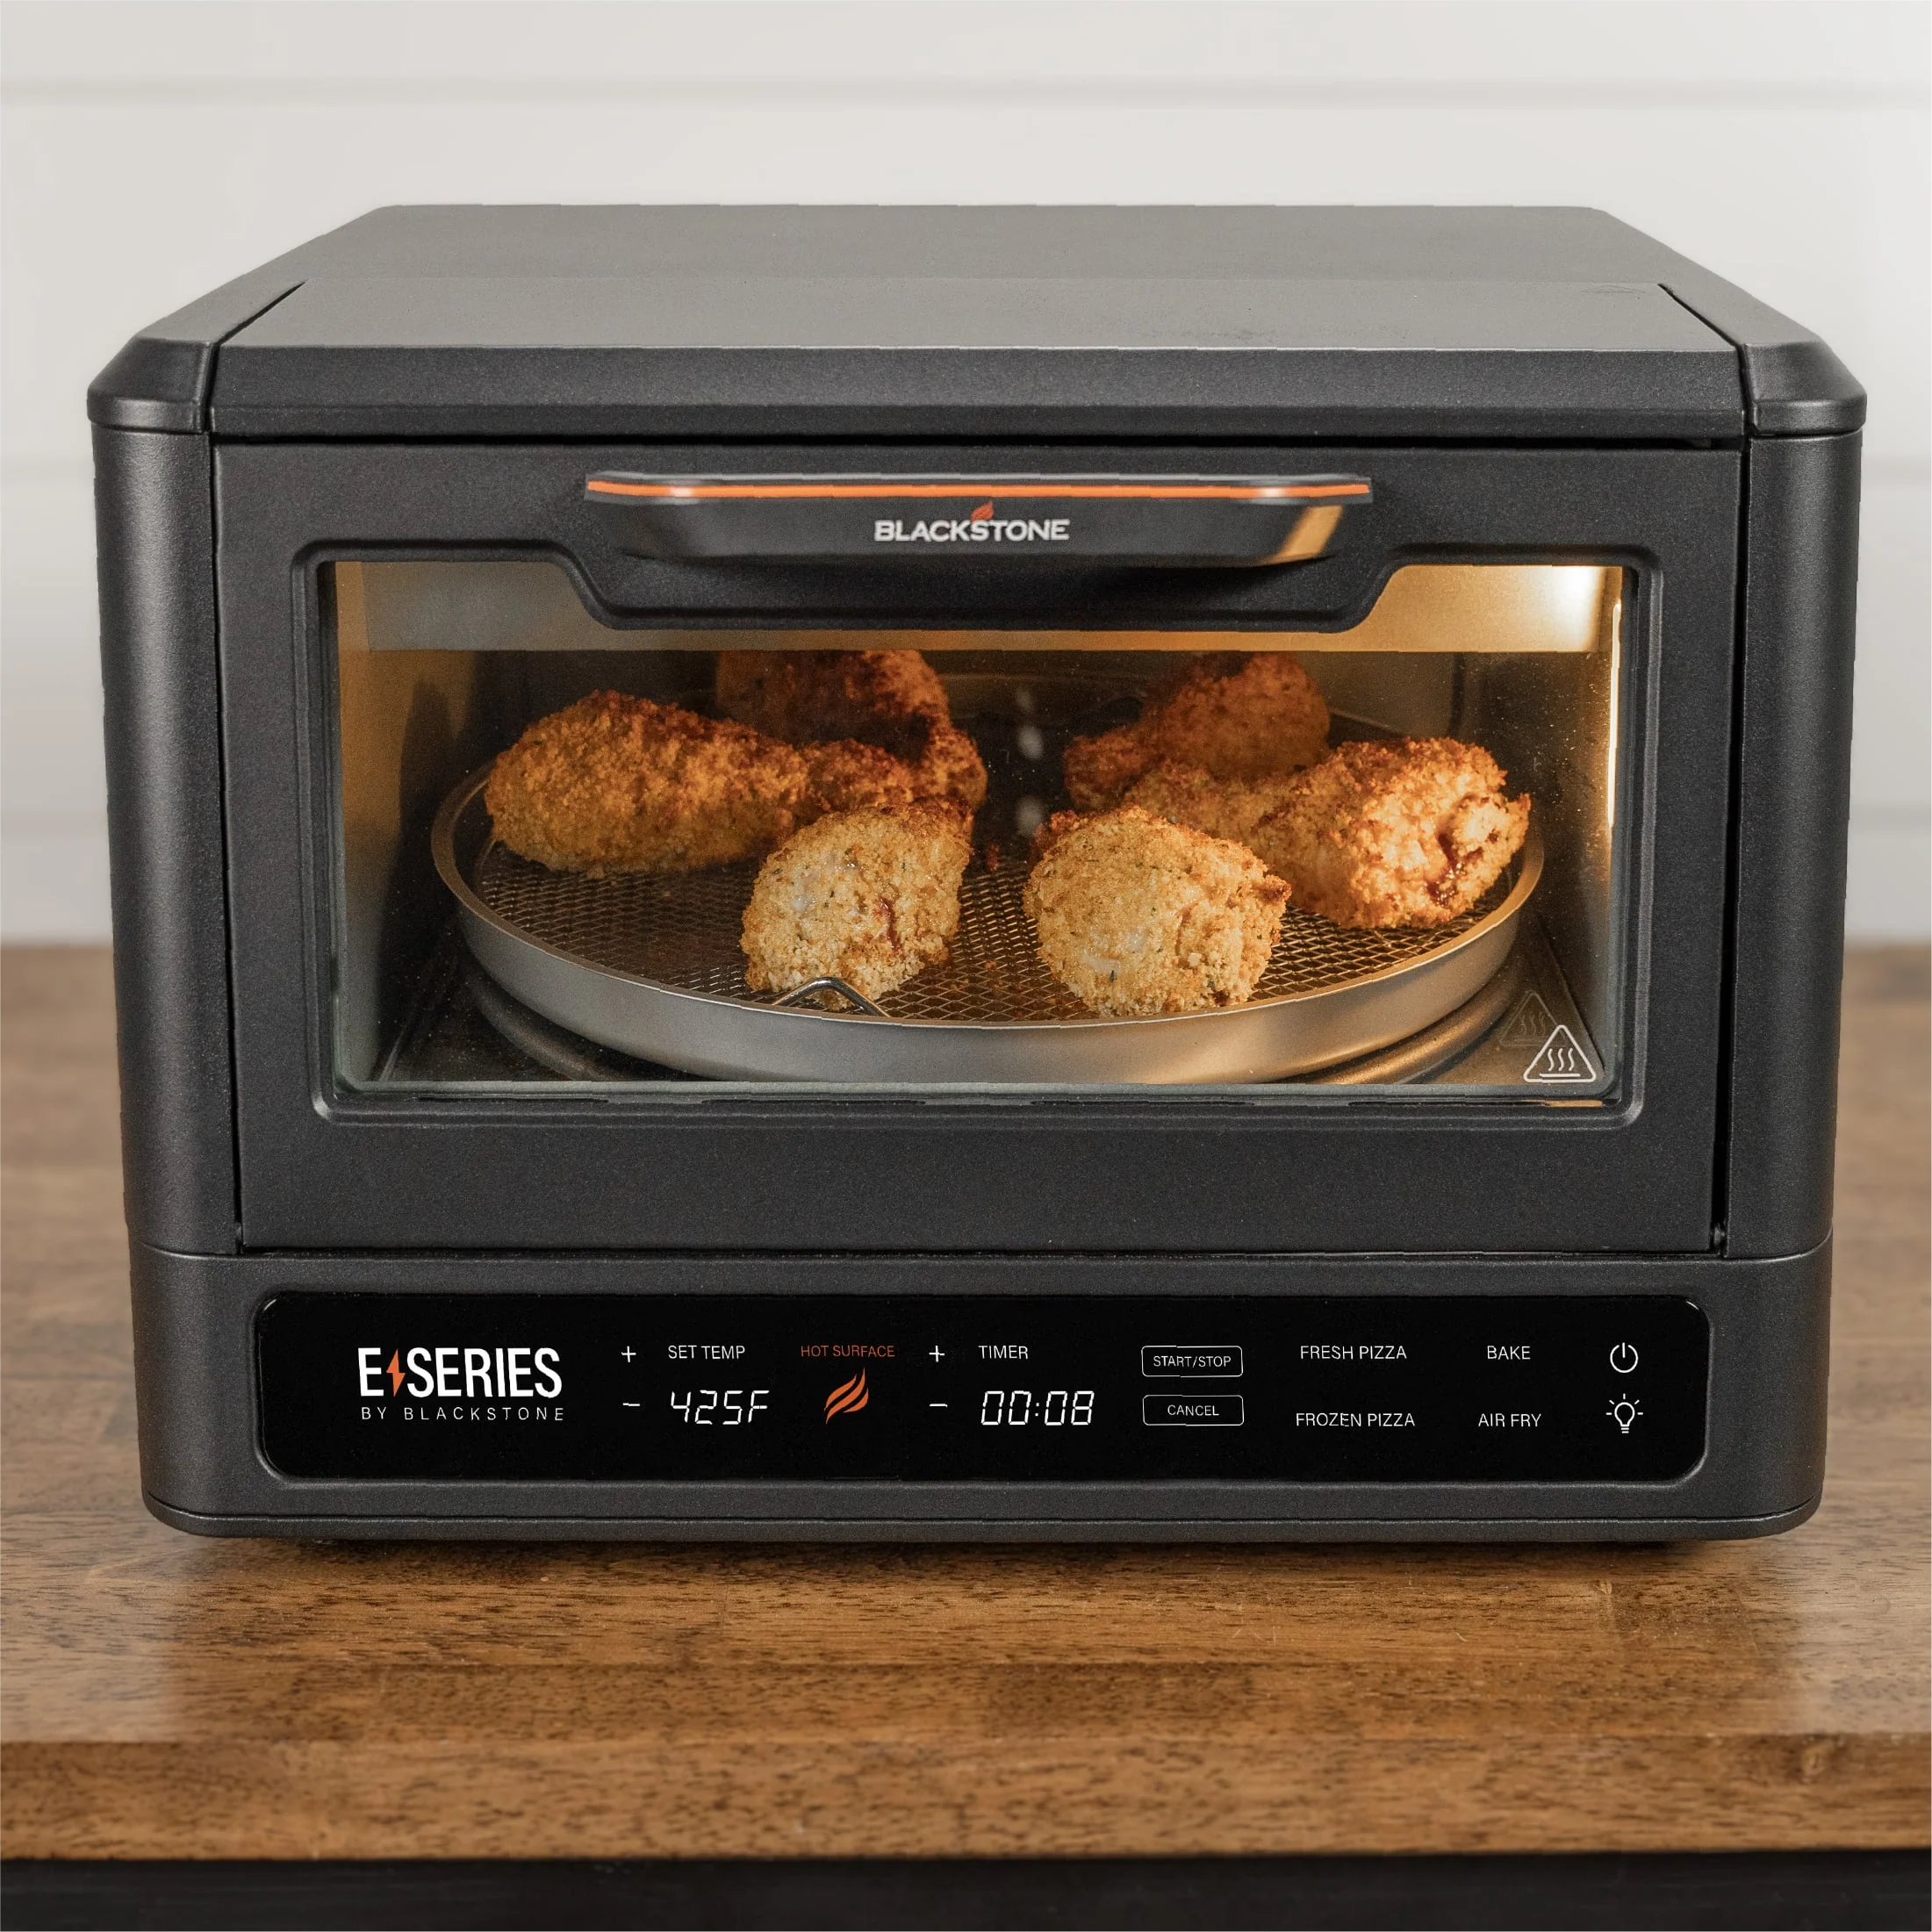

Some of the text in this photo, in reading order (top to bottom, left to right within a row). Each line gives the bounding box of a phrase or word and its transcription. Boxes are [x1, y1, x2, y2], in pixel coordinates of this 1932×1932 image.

[874, 519, 1070, 542] BLACKSTONE
[668, 1345, 745, 1360] SET TEMP
[801, 1345, 895, 1358] HOT SURFACE
[978, 1345, 1029, 1360] TIMER
[1300, 1345, 1407, 1360] FRESH PIZZA
[1487, 1345, 1531, 1361] BAKE
[1153, 1355, 1232, 1368] START/STOP
[362, 1406, 564, 1421] BY BLACKSTONE
[670, 1390, 770, 1426] 425F
[980, 1390, 1095, 1426] 00:08
[1167, 1404, 1220, 1417] CANCEL
[1296, 1412, 1416, 1427] FROZEN PIZZA
[1477, 1412, 1542, 1427] AIR FRY
